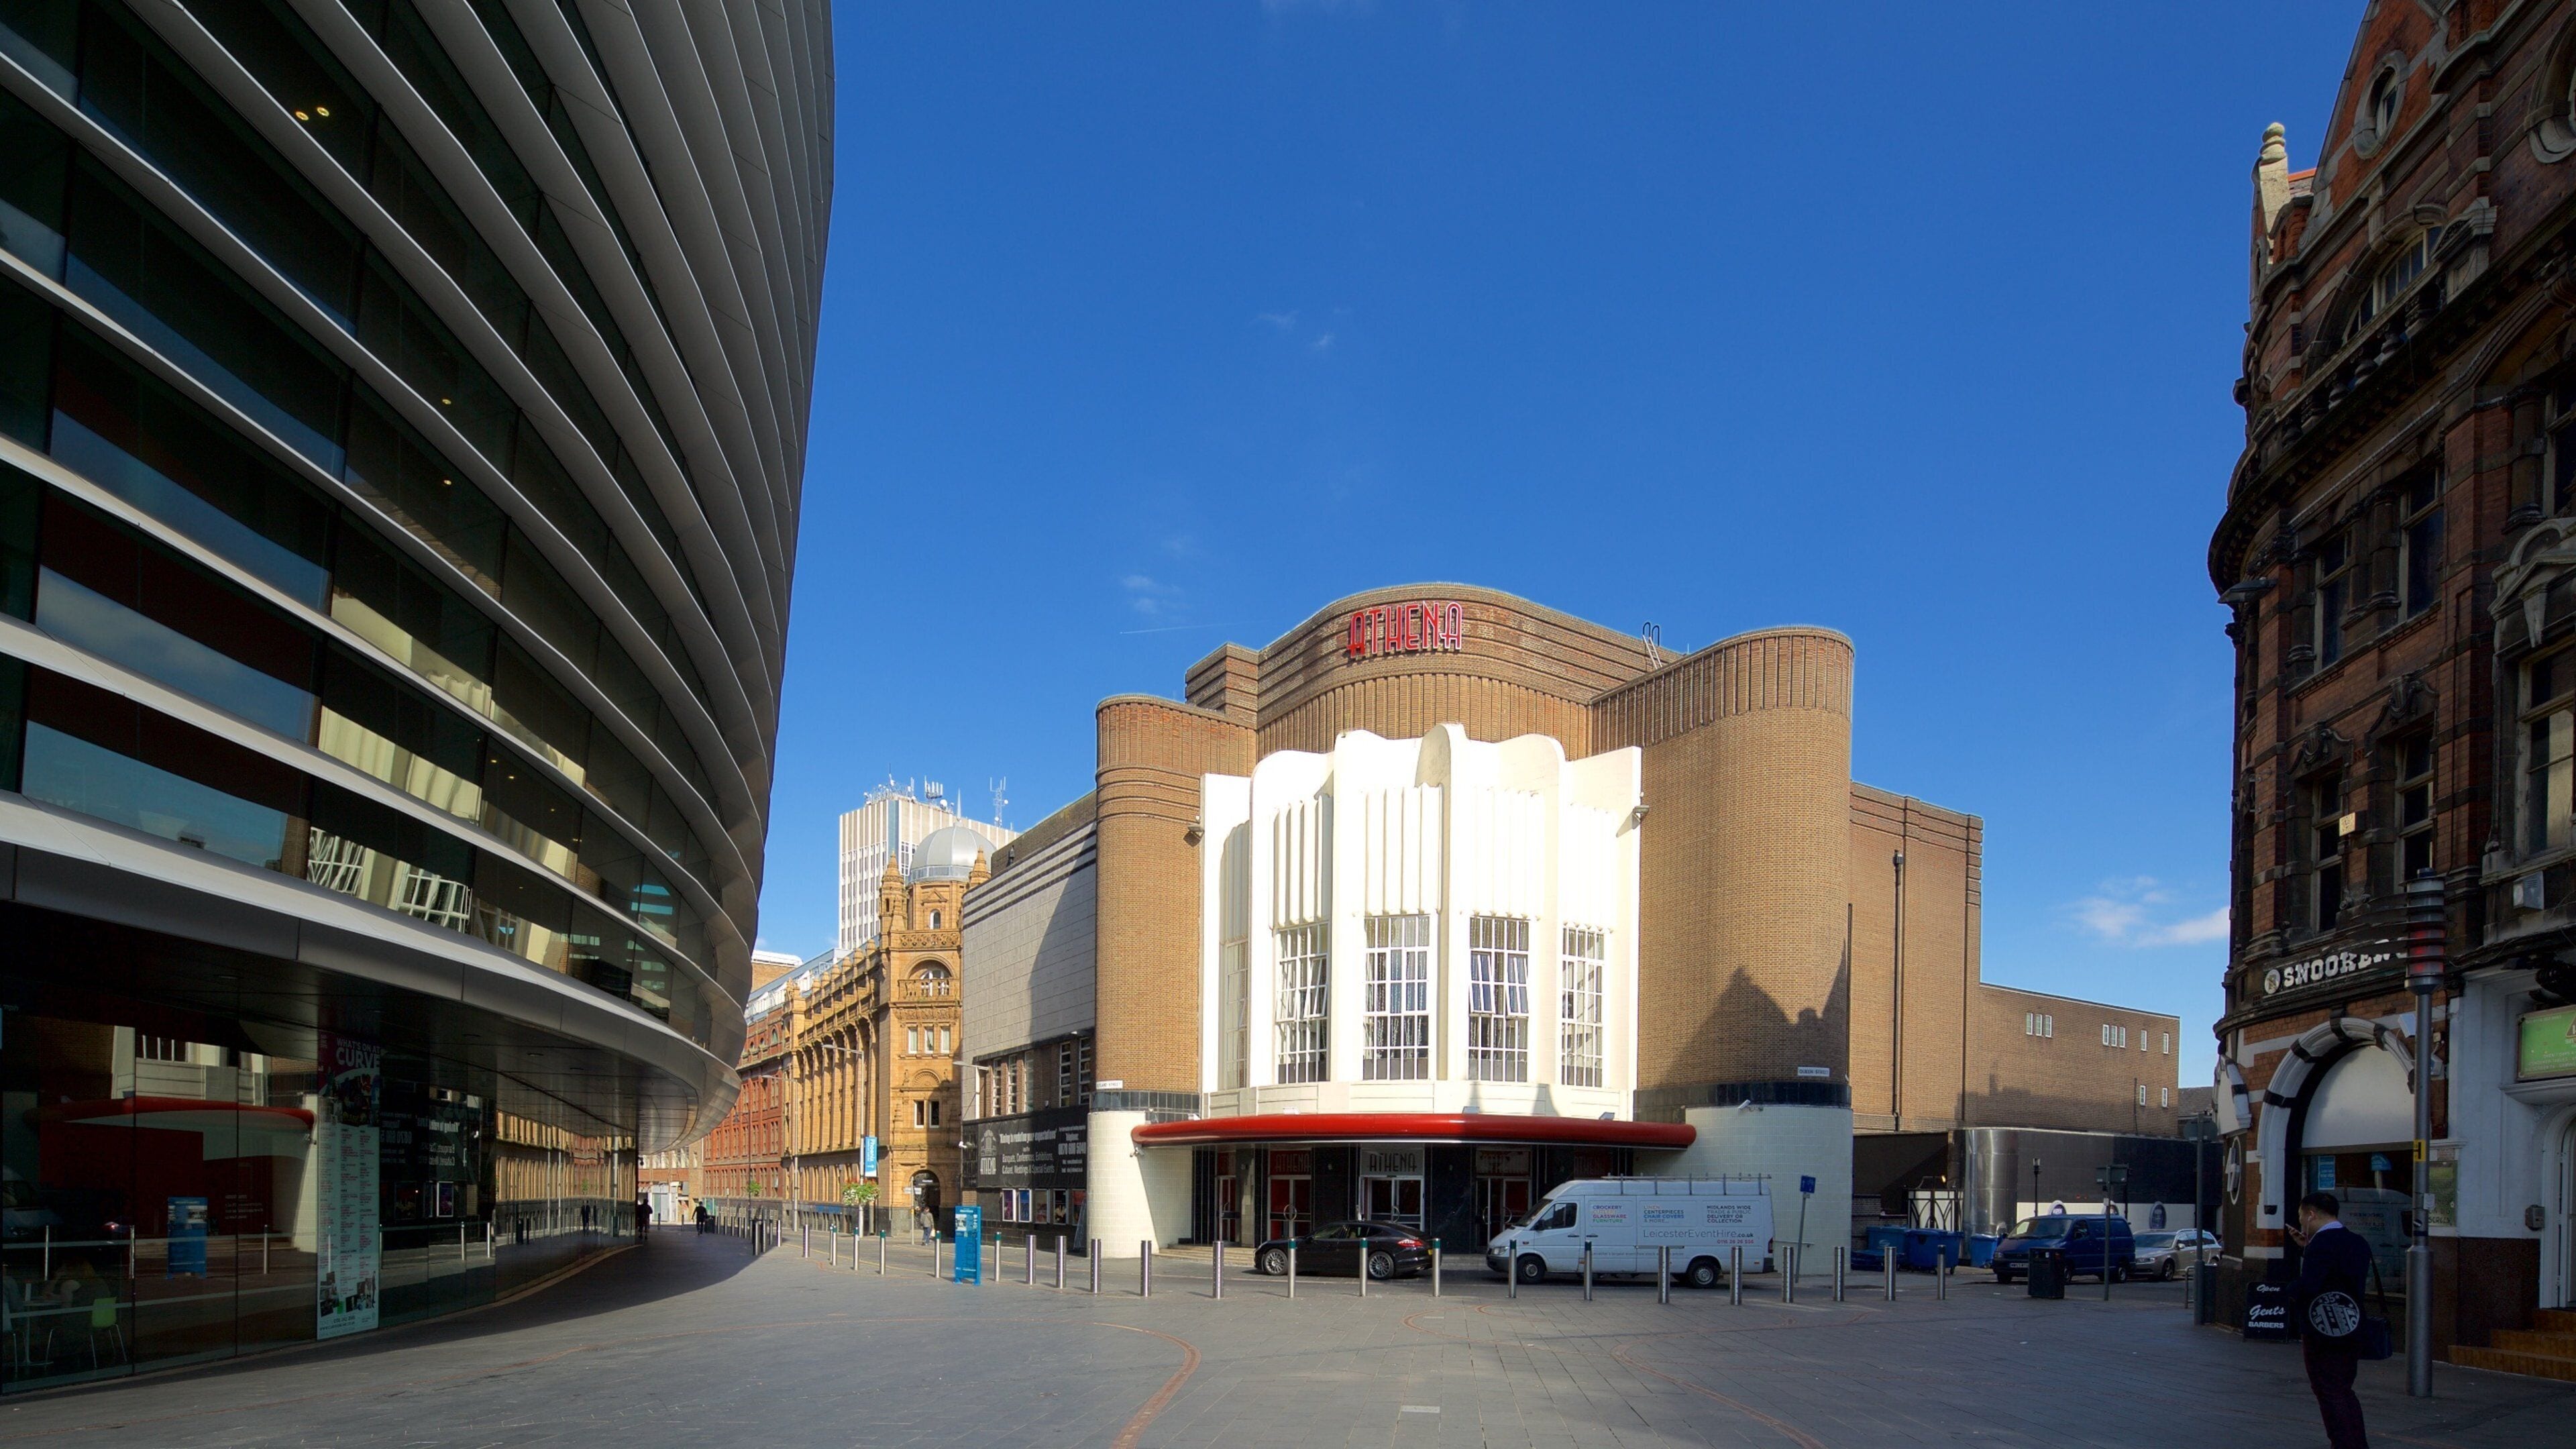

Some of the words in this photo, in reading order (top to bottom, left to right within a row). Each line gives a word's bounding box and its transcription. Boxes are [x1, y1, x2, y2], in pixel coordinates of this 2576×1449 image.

[1346, 601, 1462, 658] ATHENA
[337, 1038, 361, 1051] WHAT'S
[336, 1047, 380, 1068] CURVE
[1369, 1152, 1417, 1172] ATHENA
[1644, 1229, 1754, 1238] LeicesterEventHire.co.uk
[2256, 1284, 2280, 1293] Open
[2322, 1293, 2336, 1304] 35
[2249, 1304, 2286, 1320] Gents
